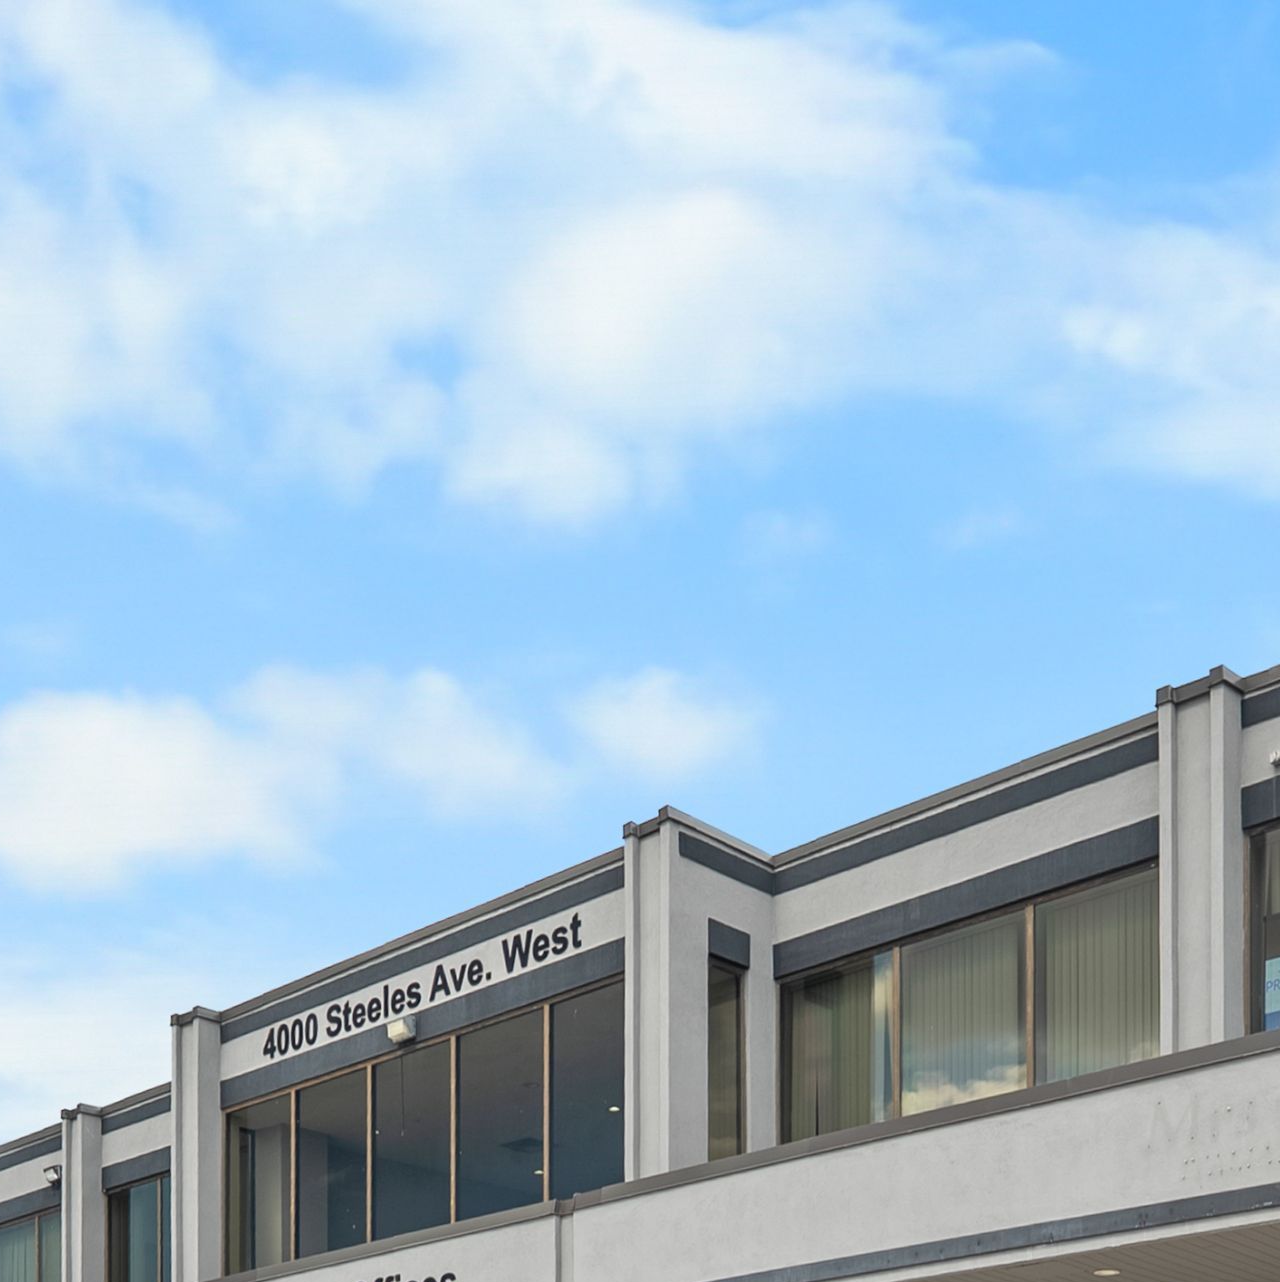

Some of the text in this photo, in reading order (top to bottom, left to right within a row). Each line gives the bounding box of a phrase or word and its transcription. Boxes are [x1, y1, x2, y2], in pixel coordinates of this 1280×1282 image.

[262, 912, 583, 1059] 4000 Steeles Ave. West
